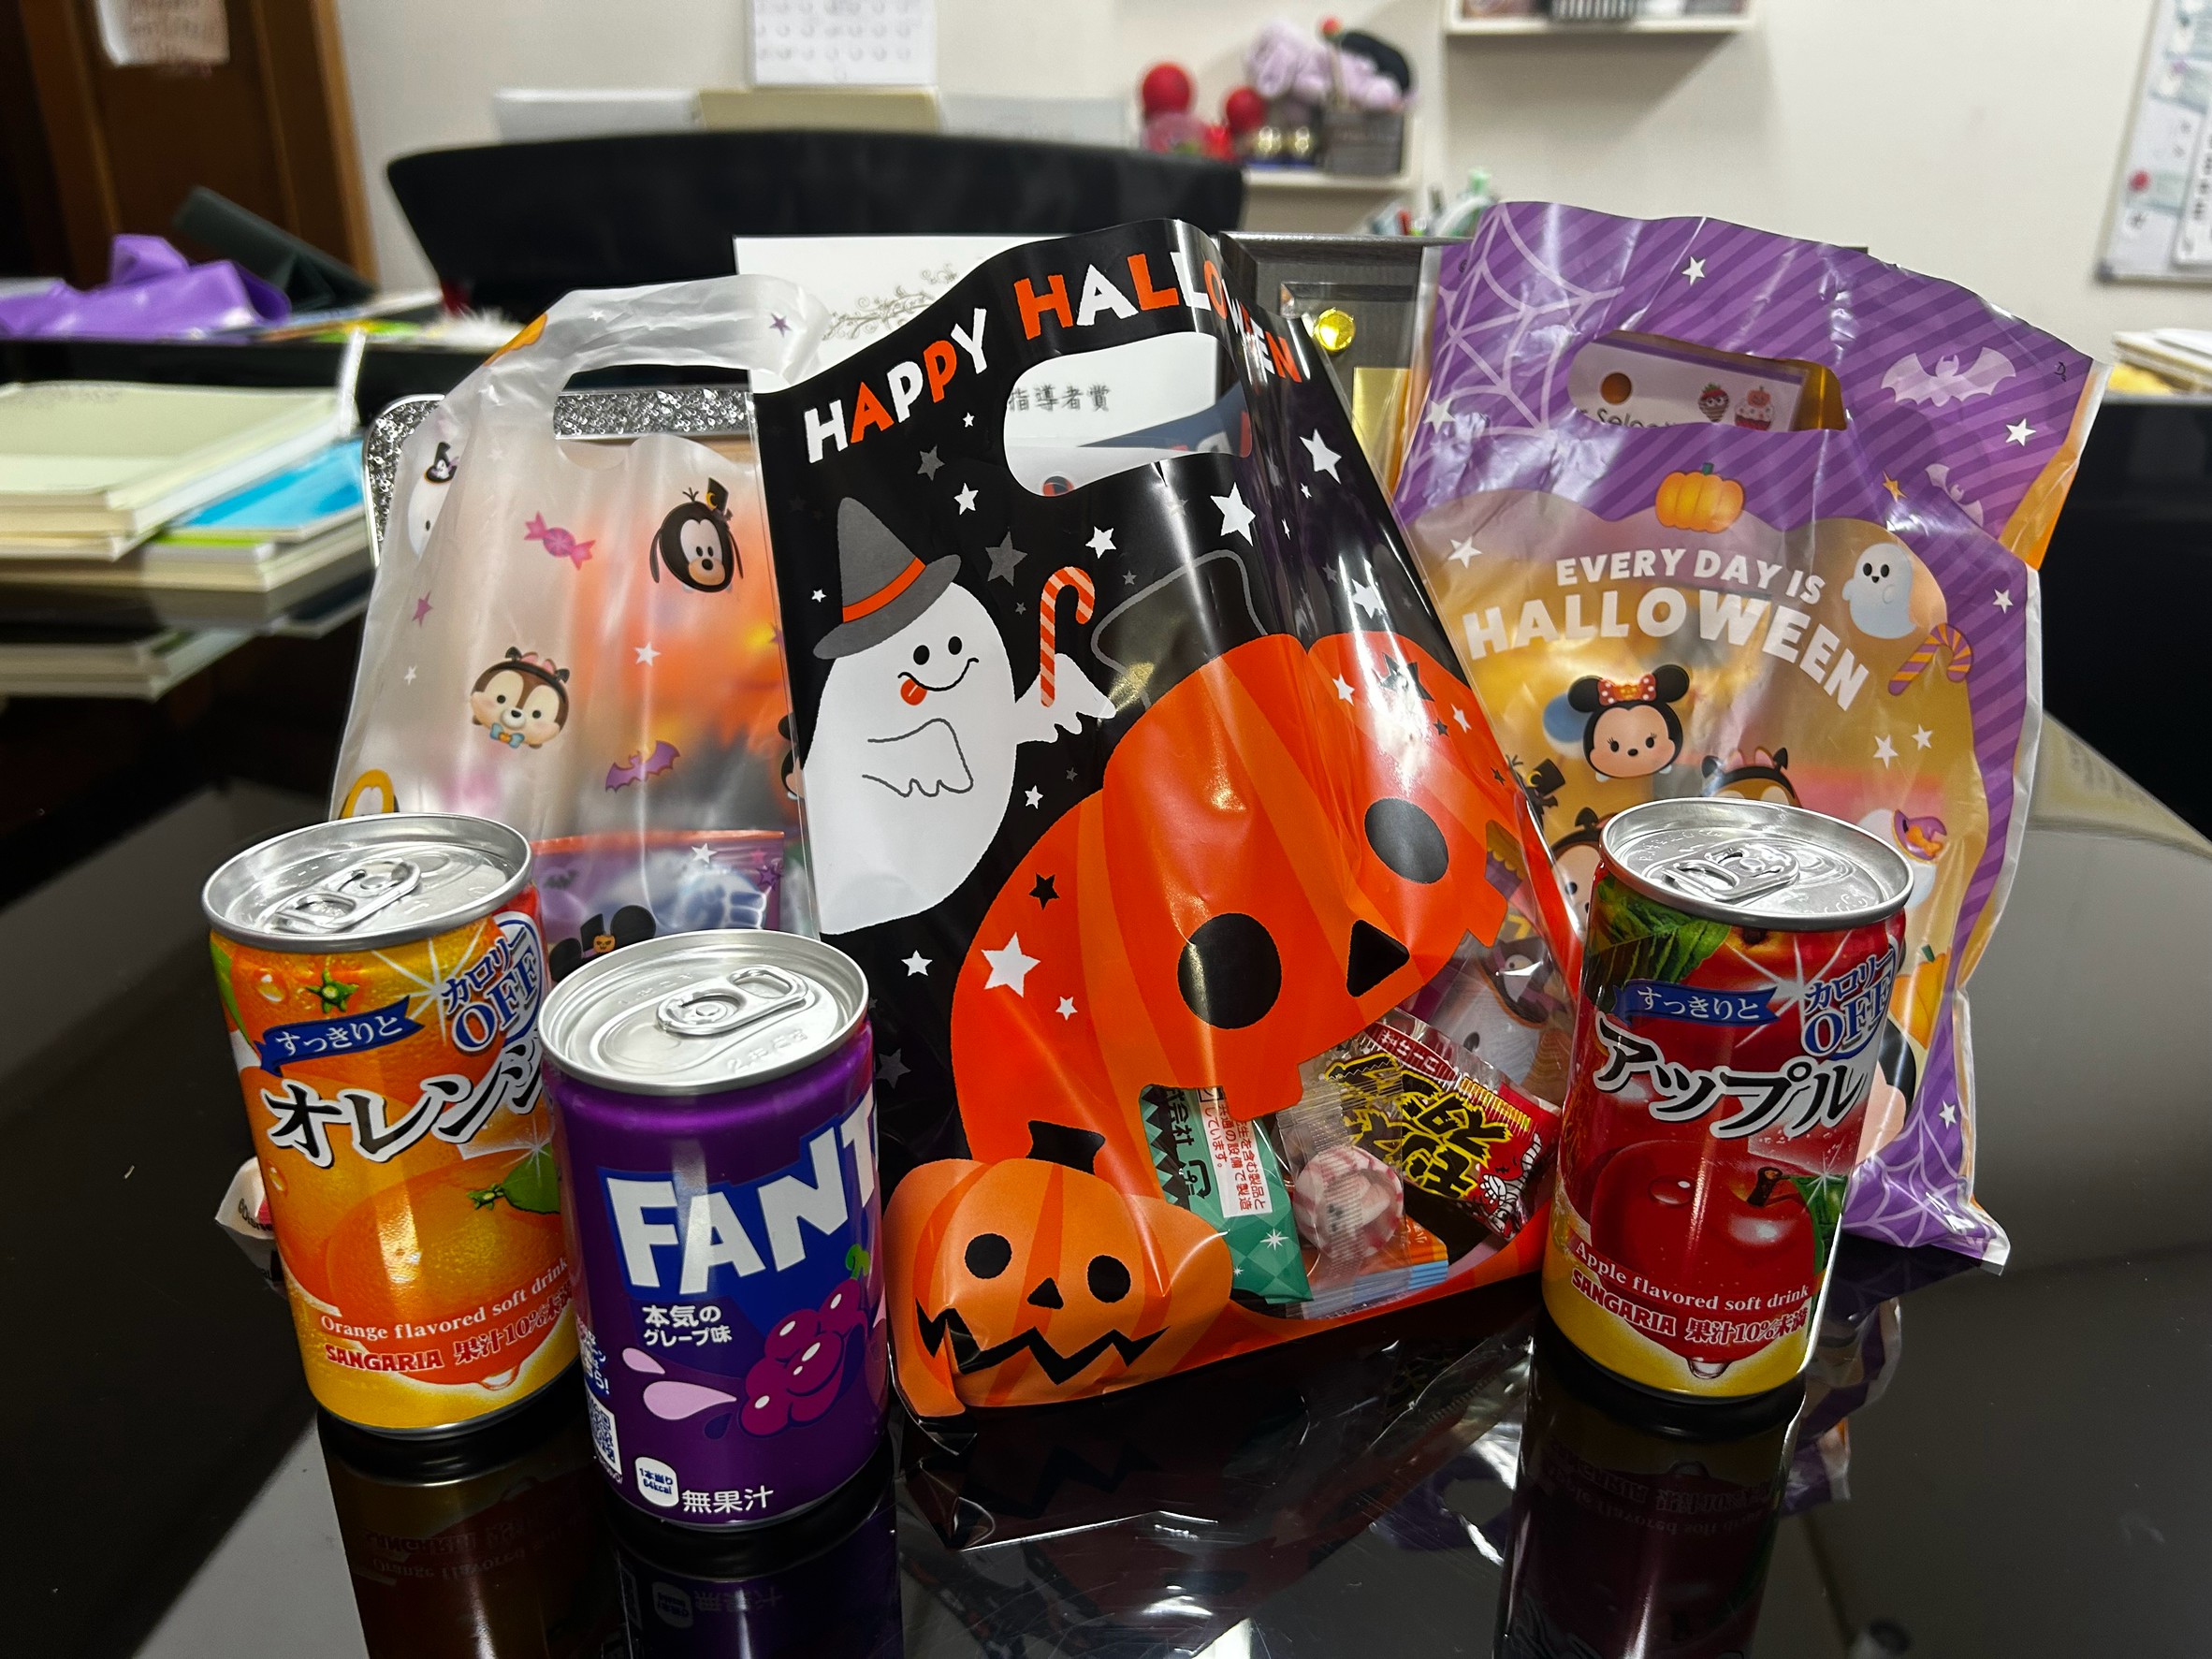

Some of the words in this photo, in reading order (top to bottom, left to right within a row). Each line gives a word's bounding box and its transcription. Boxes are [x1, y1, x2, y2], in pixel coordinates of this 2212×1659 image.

[804, 308, 987, 464] HAPPY
[1013, 253, 1303, 385] HALLOWEEN
[1556, 548, 1686, 587] EVERY
[1694, 549, 1783, 590] DAY
[1785, 570, 1826, 605] IS
[1462, 587, 1870, 712] HALLOWEEN
[441, 925, 527, 1015] カロリー
[451, 945, 539, 1052] OFF
[1637, 985, 1760, 1021] すっきりと
[1804, 946, 1895, 1015] カロリー
[275, 1011, 407, 1056] すっきりと
[1800, 969, 1892, 1057] OFF
[1593, 1011, 1870, 1139] アップル
[1204, 1107, 1229, 1169] しています。
[606, 1084, 880, 1295] FANT
[321, 1315, 388, 1342] Orange
[394, 1306, 488, 1339] flavored
[491, 1288, 529, 1317] soft
[531, 1257, 568, 1295] drink
[1570, 1268, 1678, 1337] SANGARIA
[1576, 1241, 1627, 1285] Apple
[1632, 1275, 1719, 1311] flavored
[1724, 1291, 1762, 1312] soft
[1767, 1284, 1810, 1308] drink
[642, 1304, 721, 1328] 本気の
[643, 1325, 733, 1348] グレープ味
[325, 1343, 445, 1374] SANGARIA
[681, 1484, 775, 1514] 無果汁
